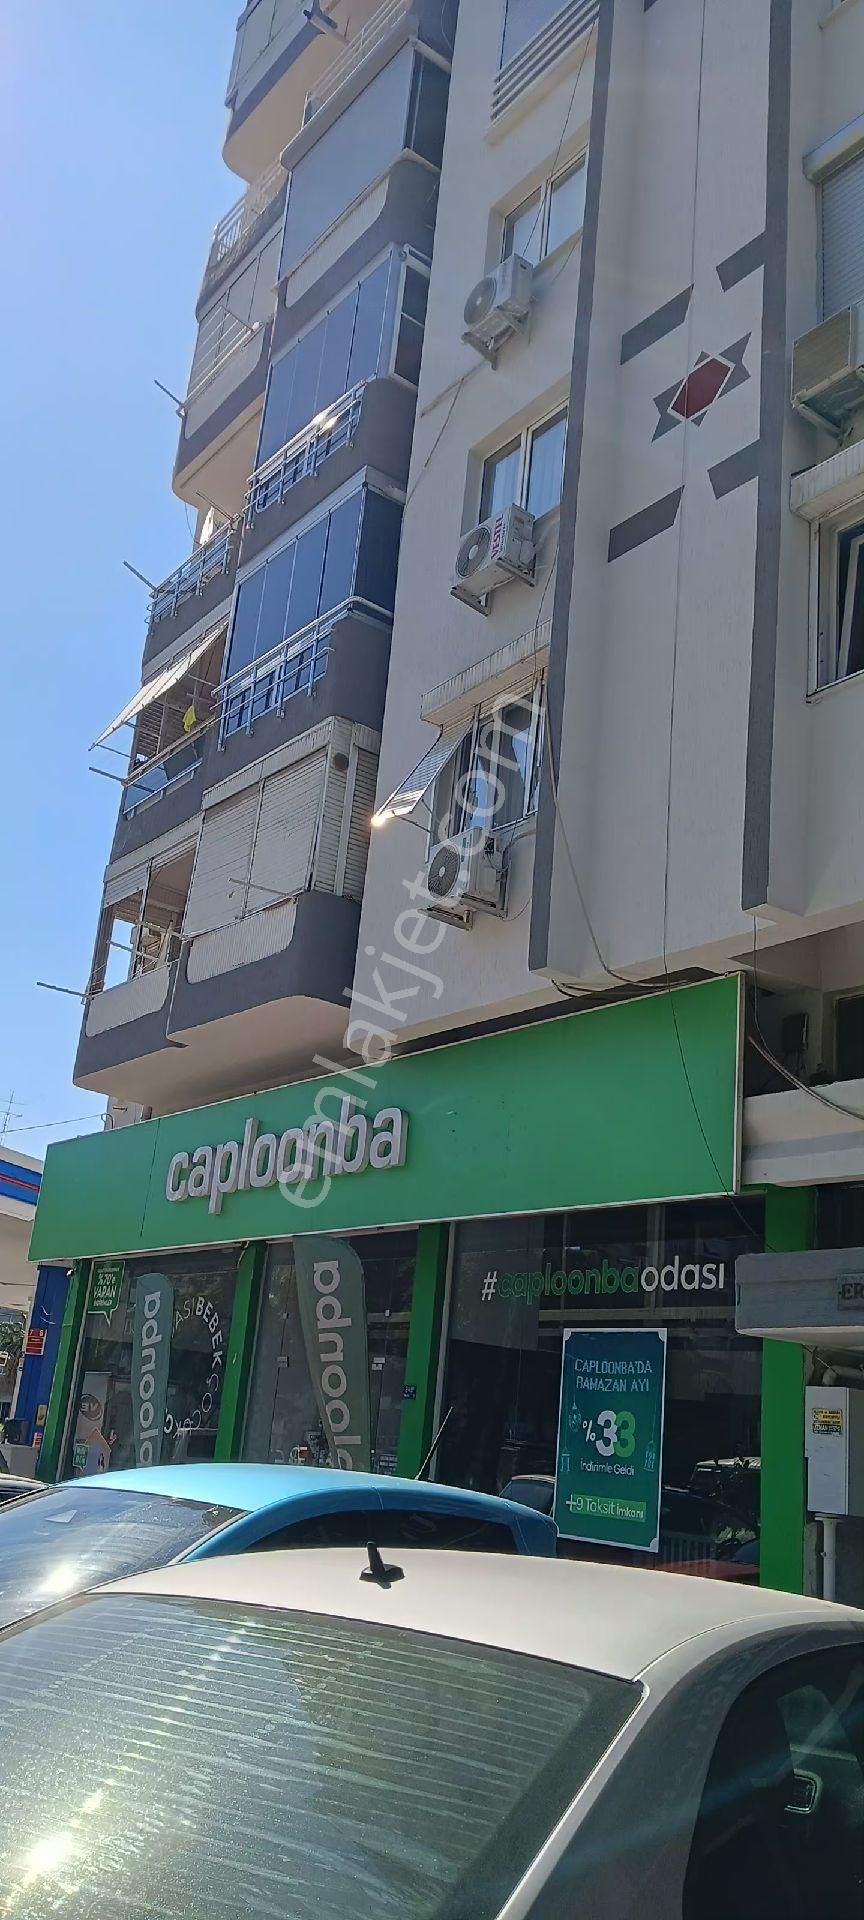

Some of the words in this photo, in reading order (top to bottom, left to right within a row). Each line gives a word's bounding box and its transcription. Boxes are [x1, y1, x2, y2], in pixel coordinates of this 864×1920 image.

[165, 1095, 409, 1215] caploonba
[574, 1359, 653, 1375] CAPLOONBA'DA
[576, 1375, 627, 1392] RAMAZAN
[630, 1378, 650, 1392] AYI
[582, 1410, 636, 1458] %33
[613, 1463, 635, 1476] Geldi
[584, 1498, 617, 1516] Taksit
